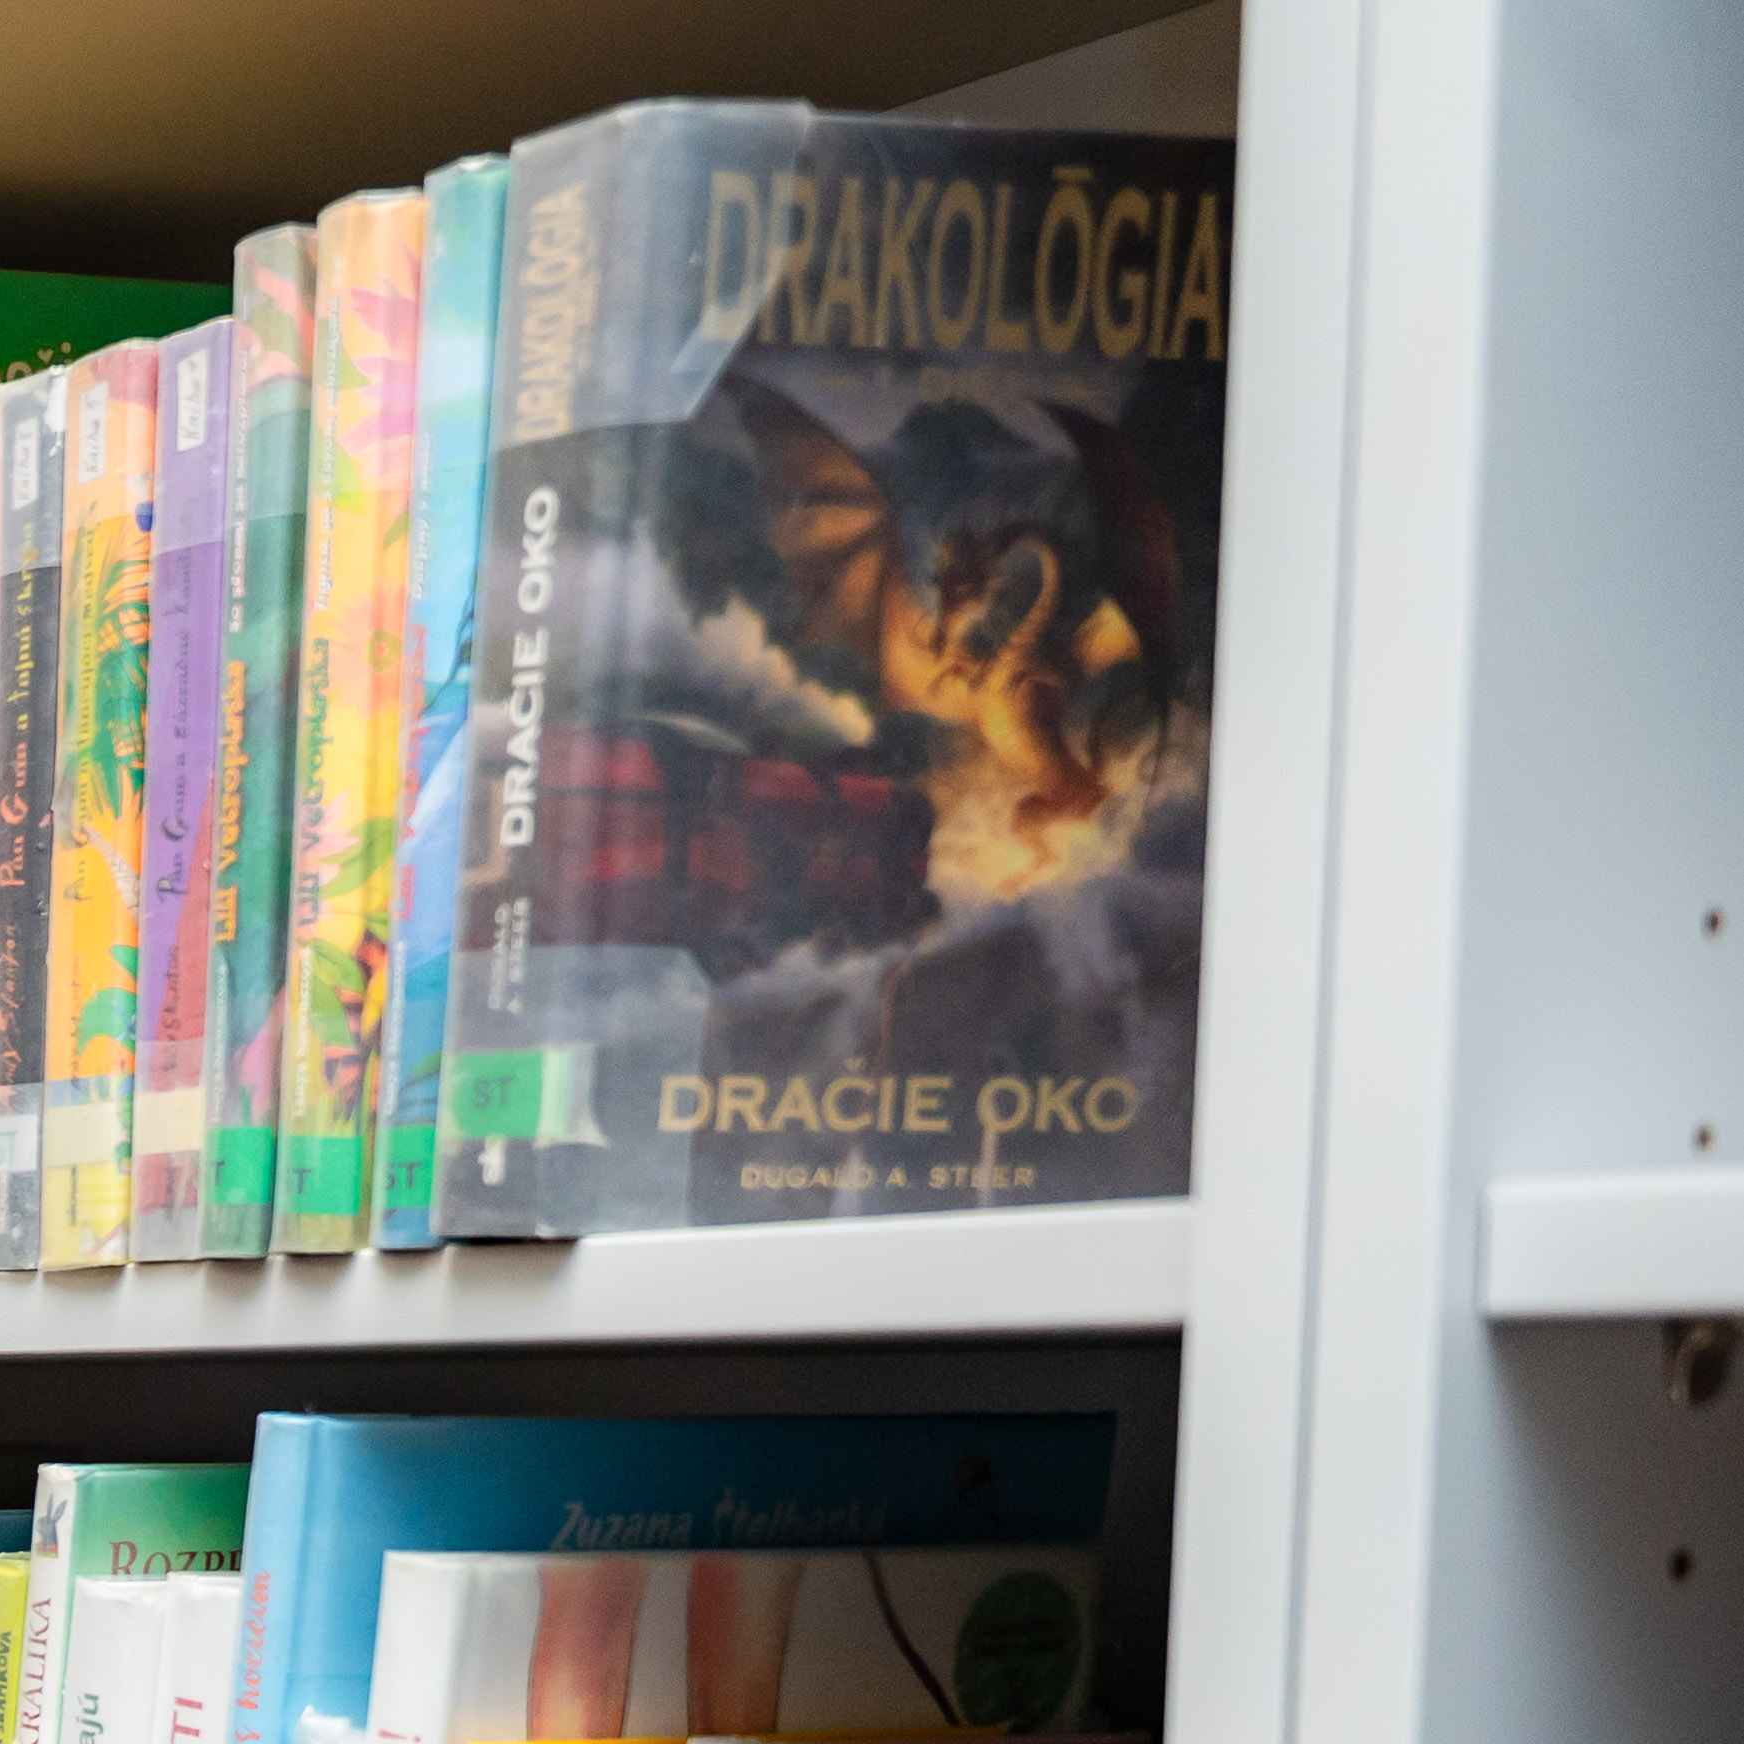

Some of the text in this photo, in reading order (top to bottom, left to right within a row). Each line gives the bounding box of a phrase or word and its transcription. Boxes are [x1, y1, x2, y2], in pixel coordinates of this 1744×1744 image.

[300, 538, 334, 853] Vetroplaška Tigrica
[496, 486, 561, 848] DRAČIE OKO
[0, 742, 30, 824] Gum
[471, 1077, 514, 1109] ST
[657, 1054, 1141, 1135] DRAČIE OKO
[548, 1497, 695, 1552] Zuzana
